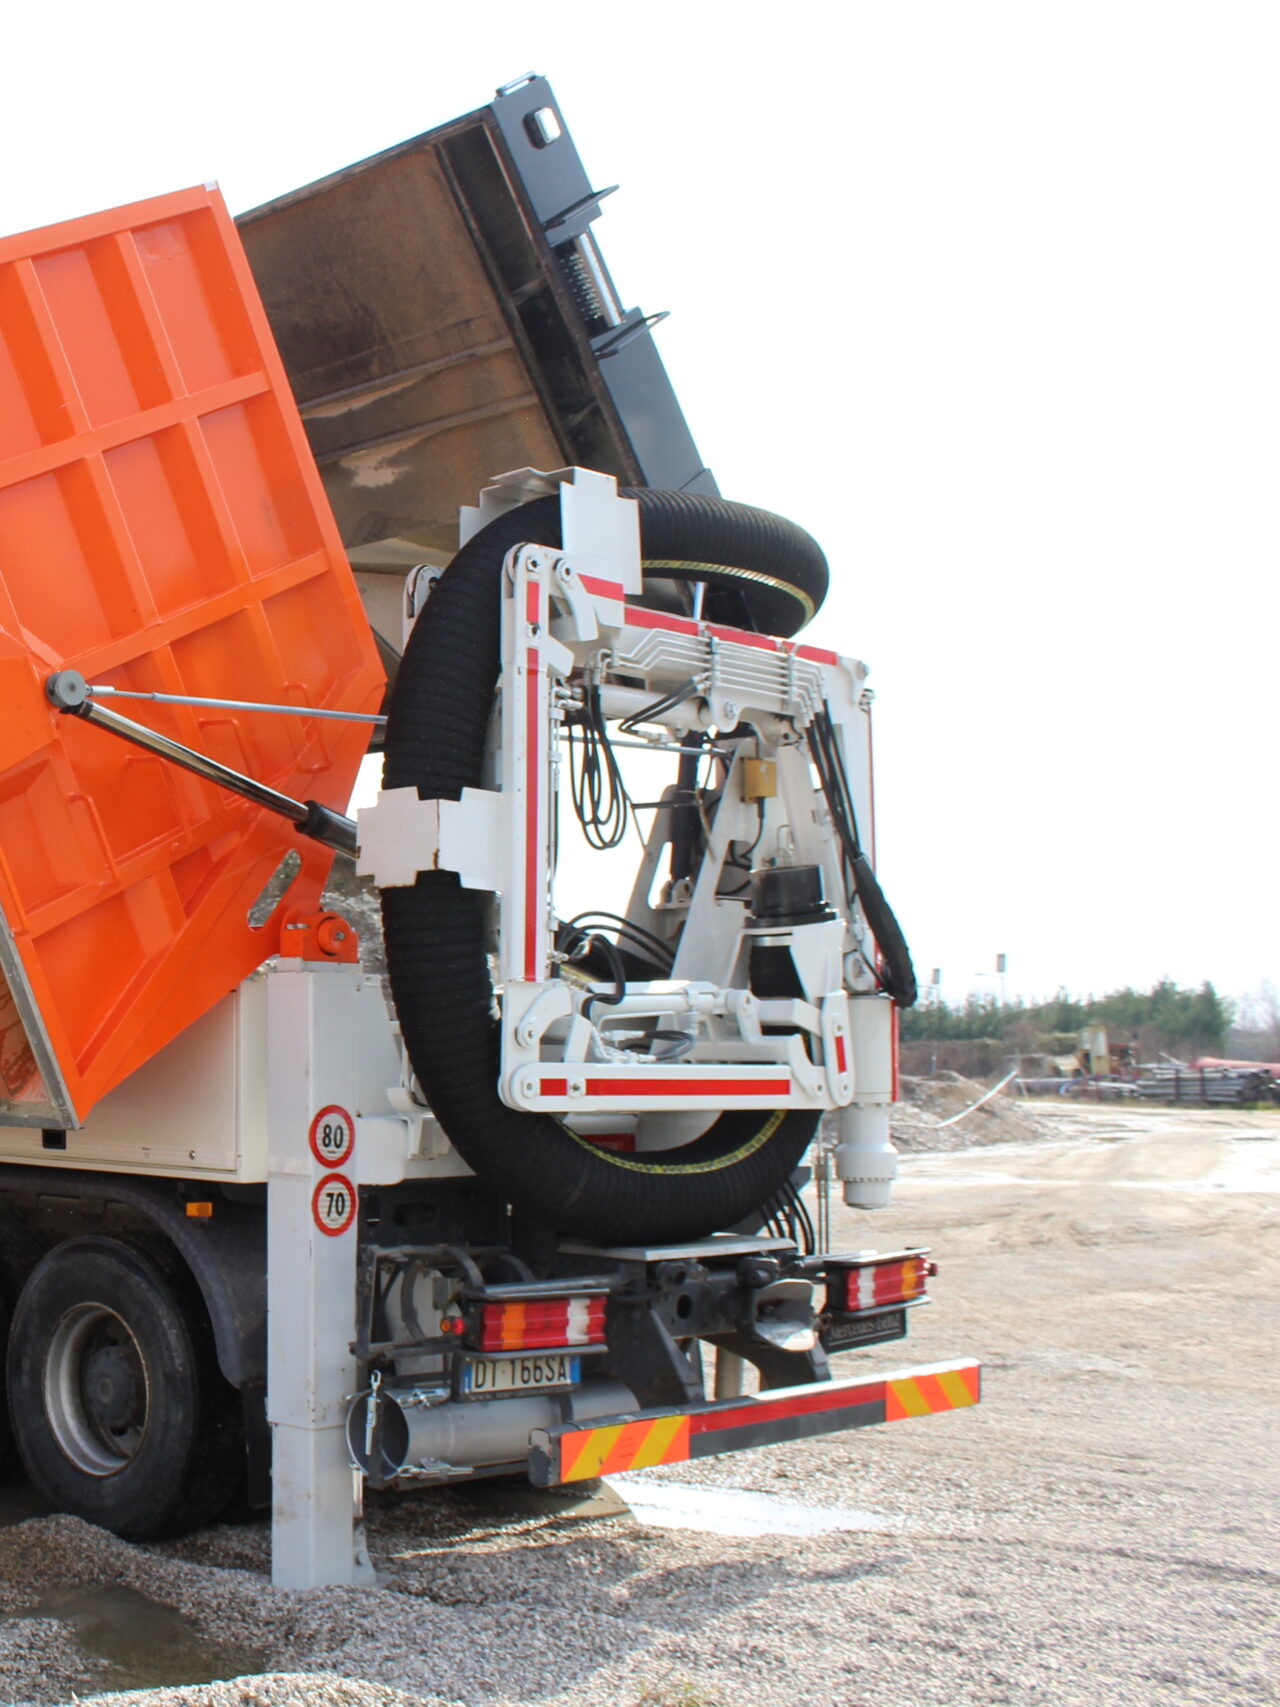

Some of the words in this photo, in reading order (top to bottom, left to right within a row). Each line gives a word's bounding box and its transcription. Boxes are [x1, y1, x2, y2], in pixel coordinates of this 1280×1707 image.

[322, 1124, 343, 1149] 80
[326, 1192, 345, 1217] 70
[510, 1355, 568, 1386] 166SA
